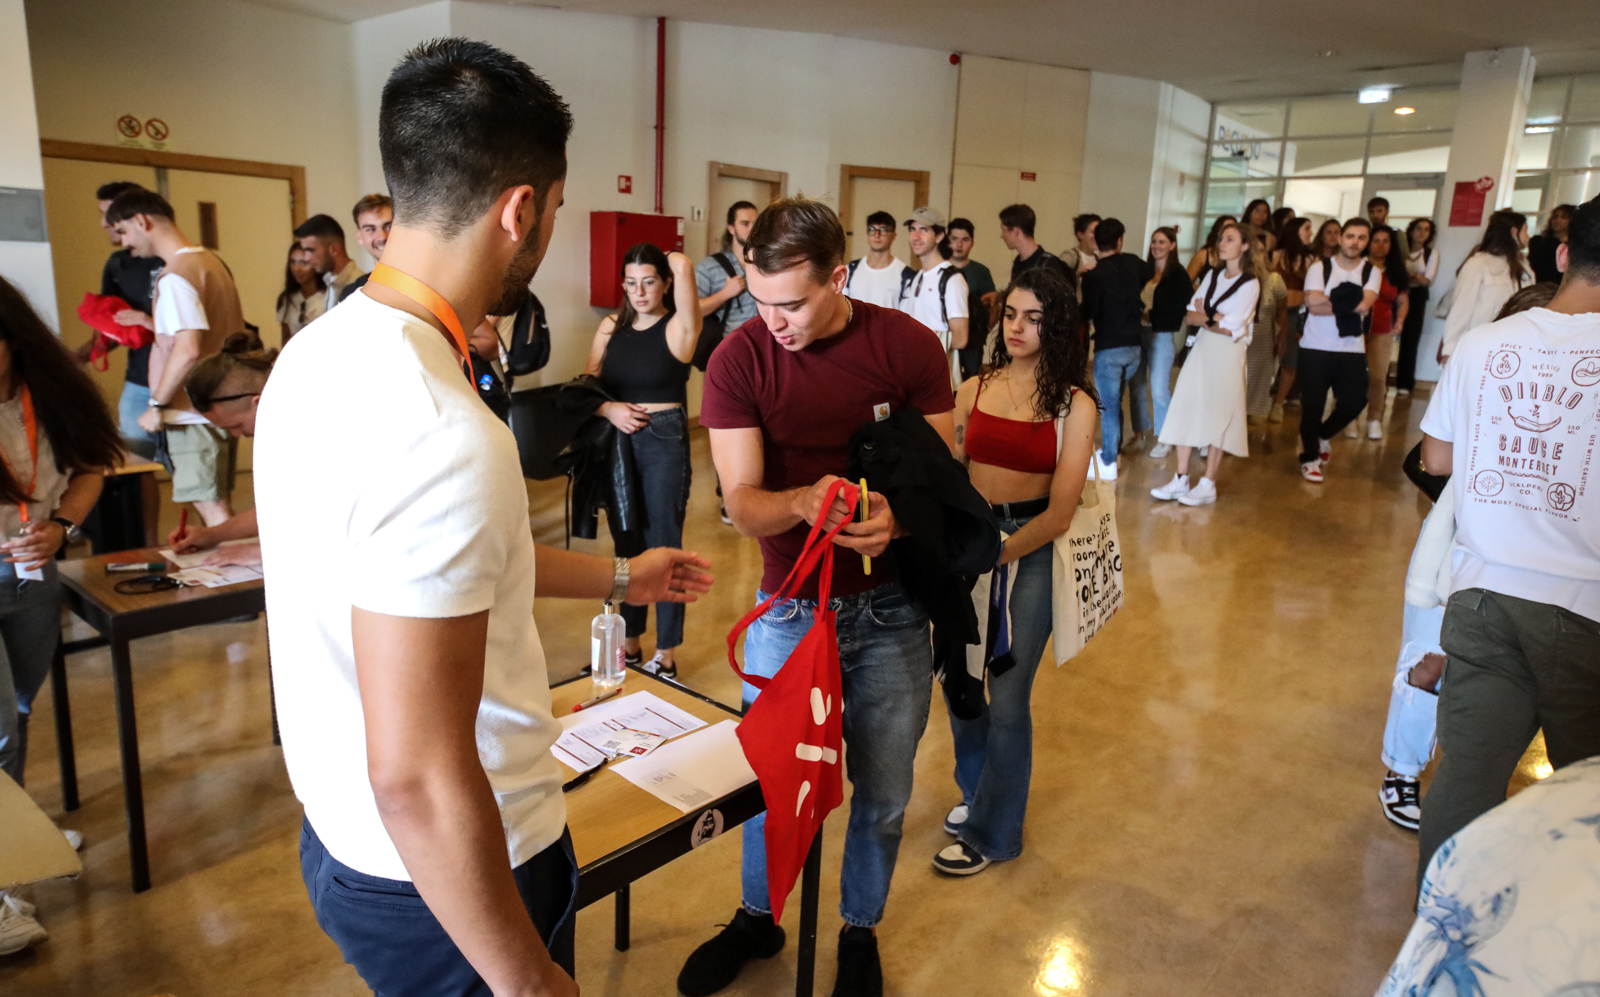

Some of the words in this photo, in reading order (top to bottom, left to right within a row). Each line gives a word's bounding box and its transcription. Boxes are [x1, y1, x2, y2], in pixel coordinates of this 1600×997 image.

[1498, 382, 1583, 410] DIABLO
[1498, 434, 1564, 460] SAUCE
[1589, 434, 1597, 446] USE
[1470, 445, 1478, 471] PEPPERS
[1498, 455, 1558, 476] MONTERREY
[1584, 448, 1593, 465] WITH
[1578, 467, 1589, 496] CAUTION
[1515, 502, 1543, 512] SPECIAL
[1072, 550, 1097, 562] room
